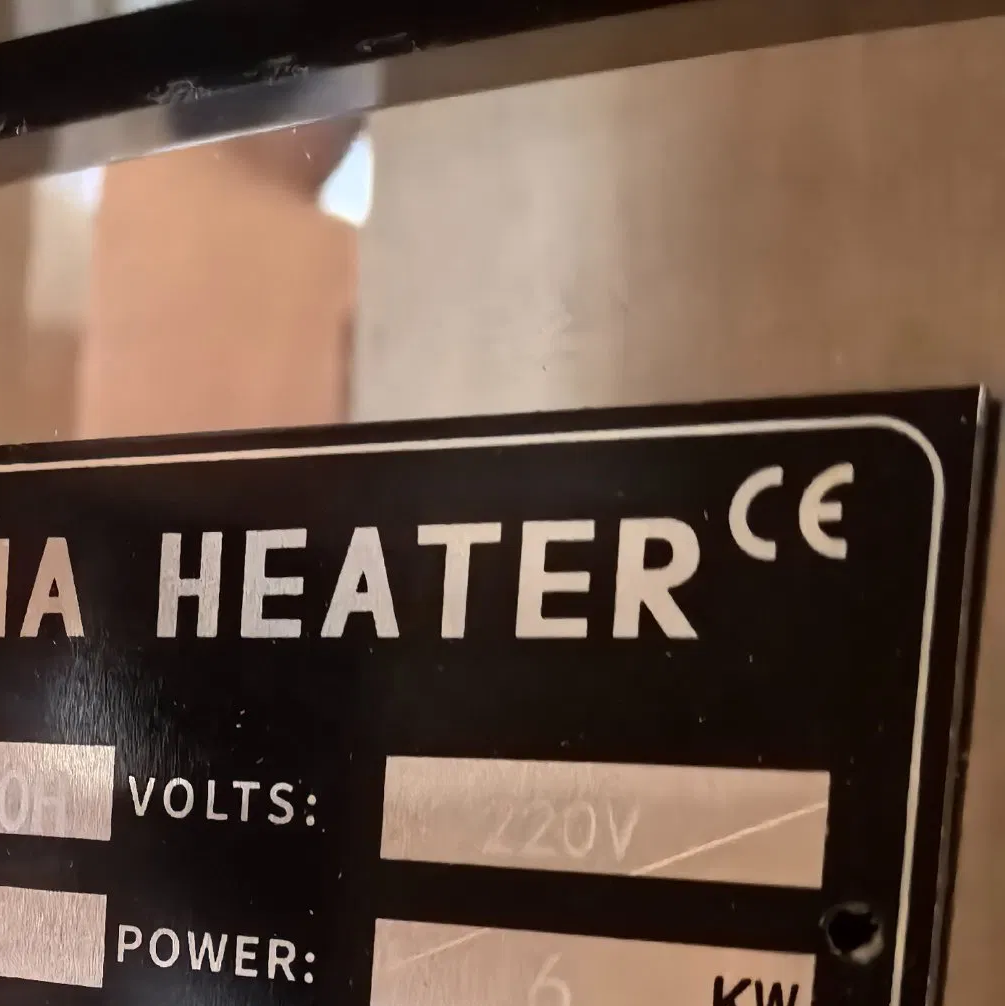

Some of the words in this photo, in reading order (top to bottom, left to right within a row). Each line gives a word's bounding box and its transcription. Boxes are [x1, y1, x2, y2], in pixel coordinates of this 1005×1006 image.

[156, 517, 701, 639] HEATER
[128, 775, 317, 827] VOLTS:
[482, 799, 642, 862] 220V
[117, 924, 315, 984] POWER:
